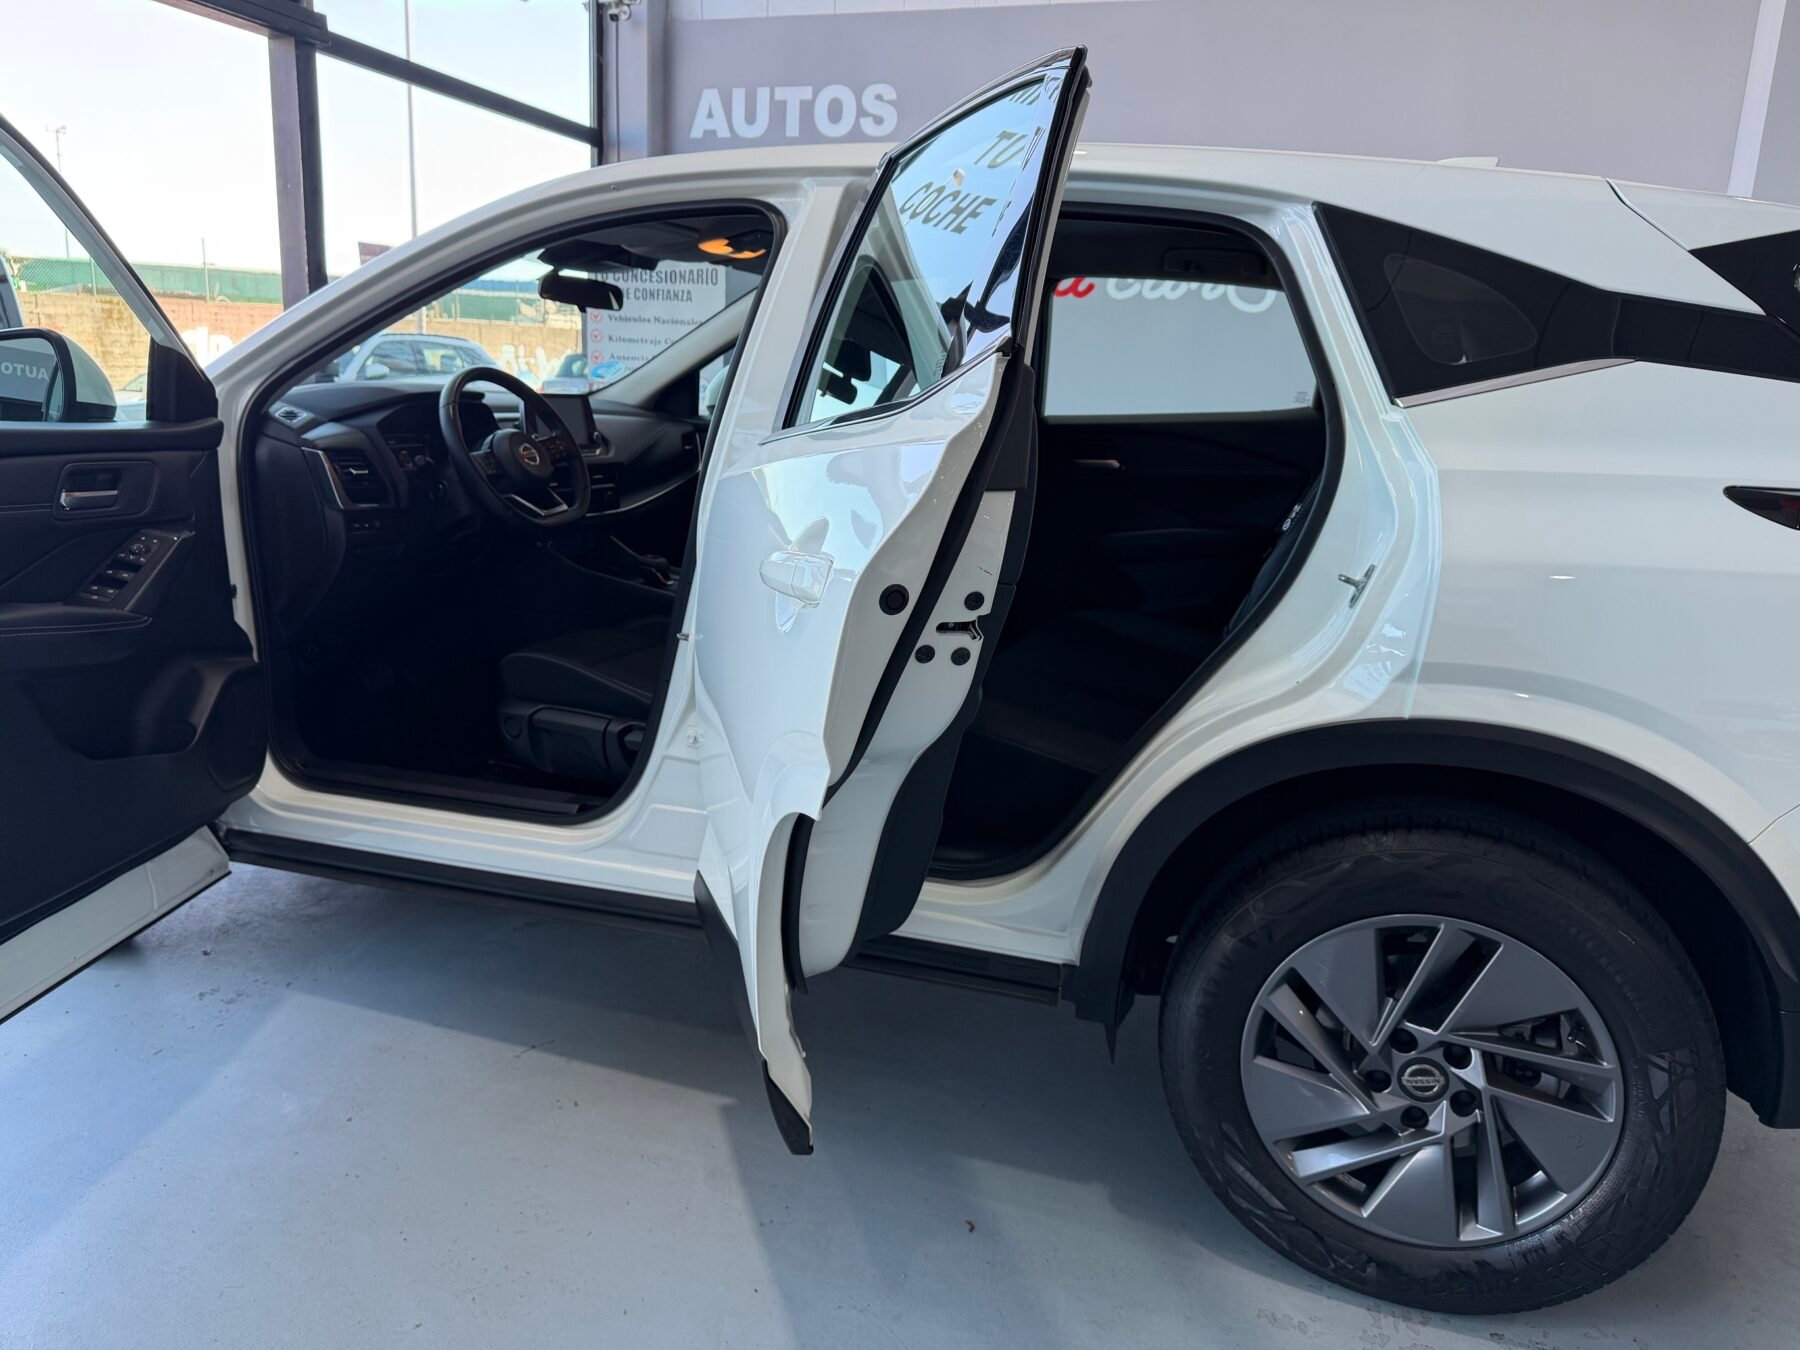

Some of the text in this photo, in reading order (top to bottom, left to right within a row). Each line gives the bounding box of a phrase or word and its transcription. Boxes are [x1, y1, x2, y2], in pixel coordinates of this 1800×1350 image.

[690, 83, 898, 139] AUTOS
[900, 181, 999, 235] COCHE
[613, 267, 719, 286] CONCESIONARIO
[634, 287, 693, 303] CONFIANZA
